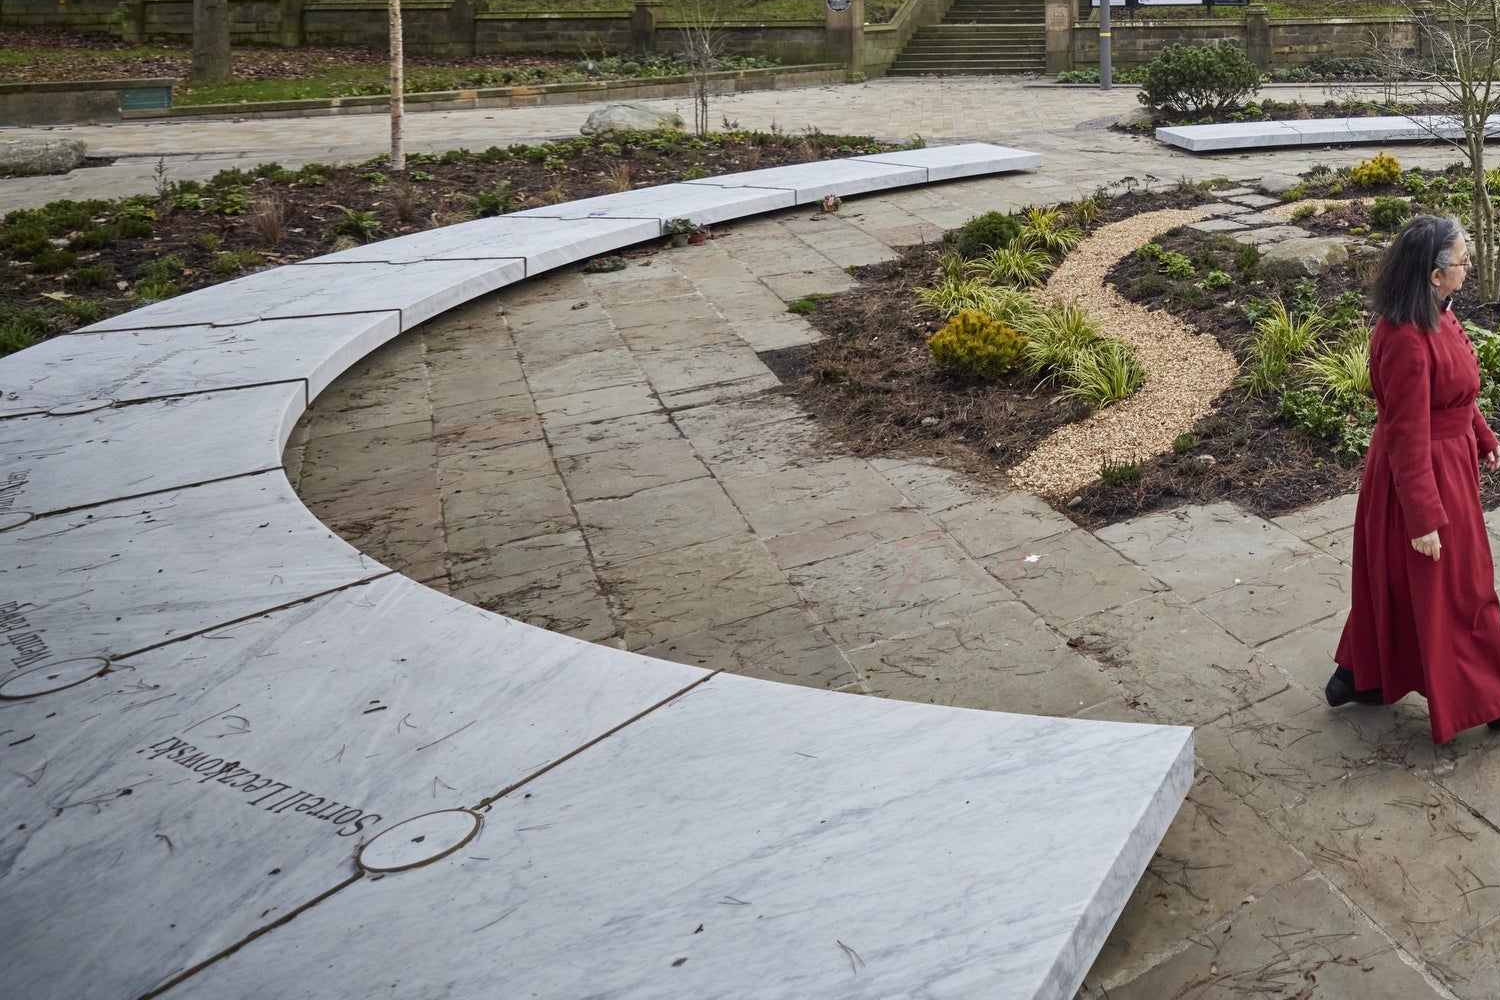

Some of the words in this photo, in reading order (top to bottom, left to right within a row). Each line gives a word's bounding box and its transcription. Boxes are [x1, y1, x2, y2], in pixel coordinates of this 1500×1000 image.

[0, 628, 55, 669] Wendy
[136, 736, 293, 806] Leczkowski
[264, 791, 383, 837] Sorrell
